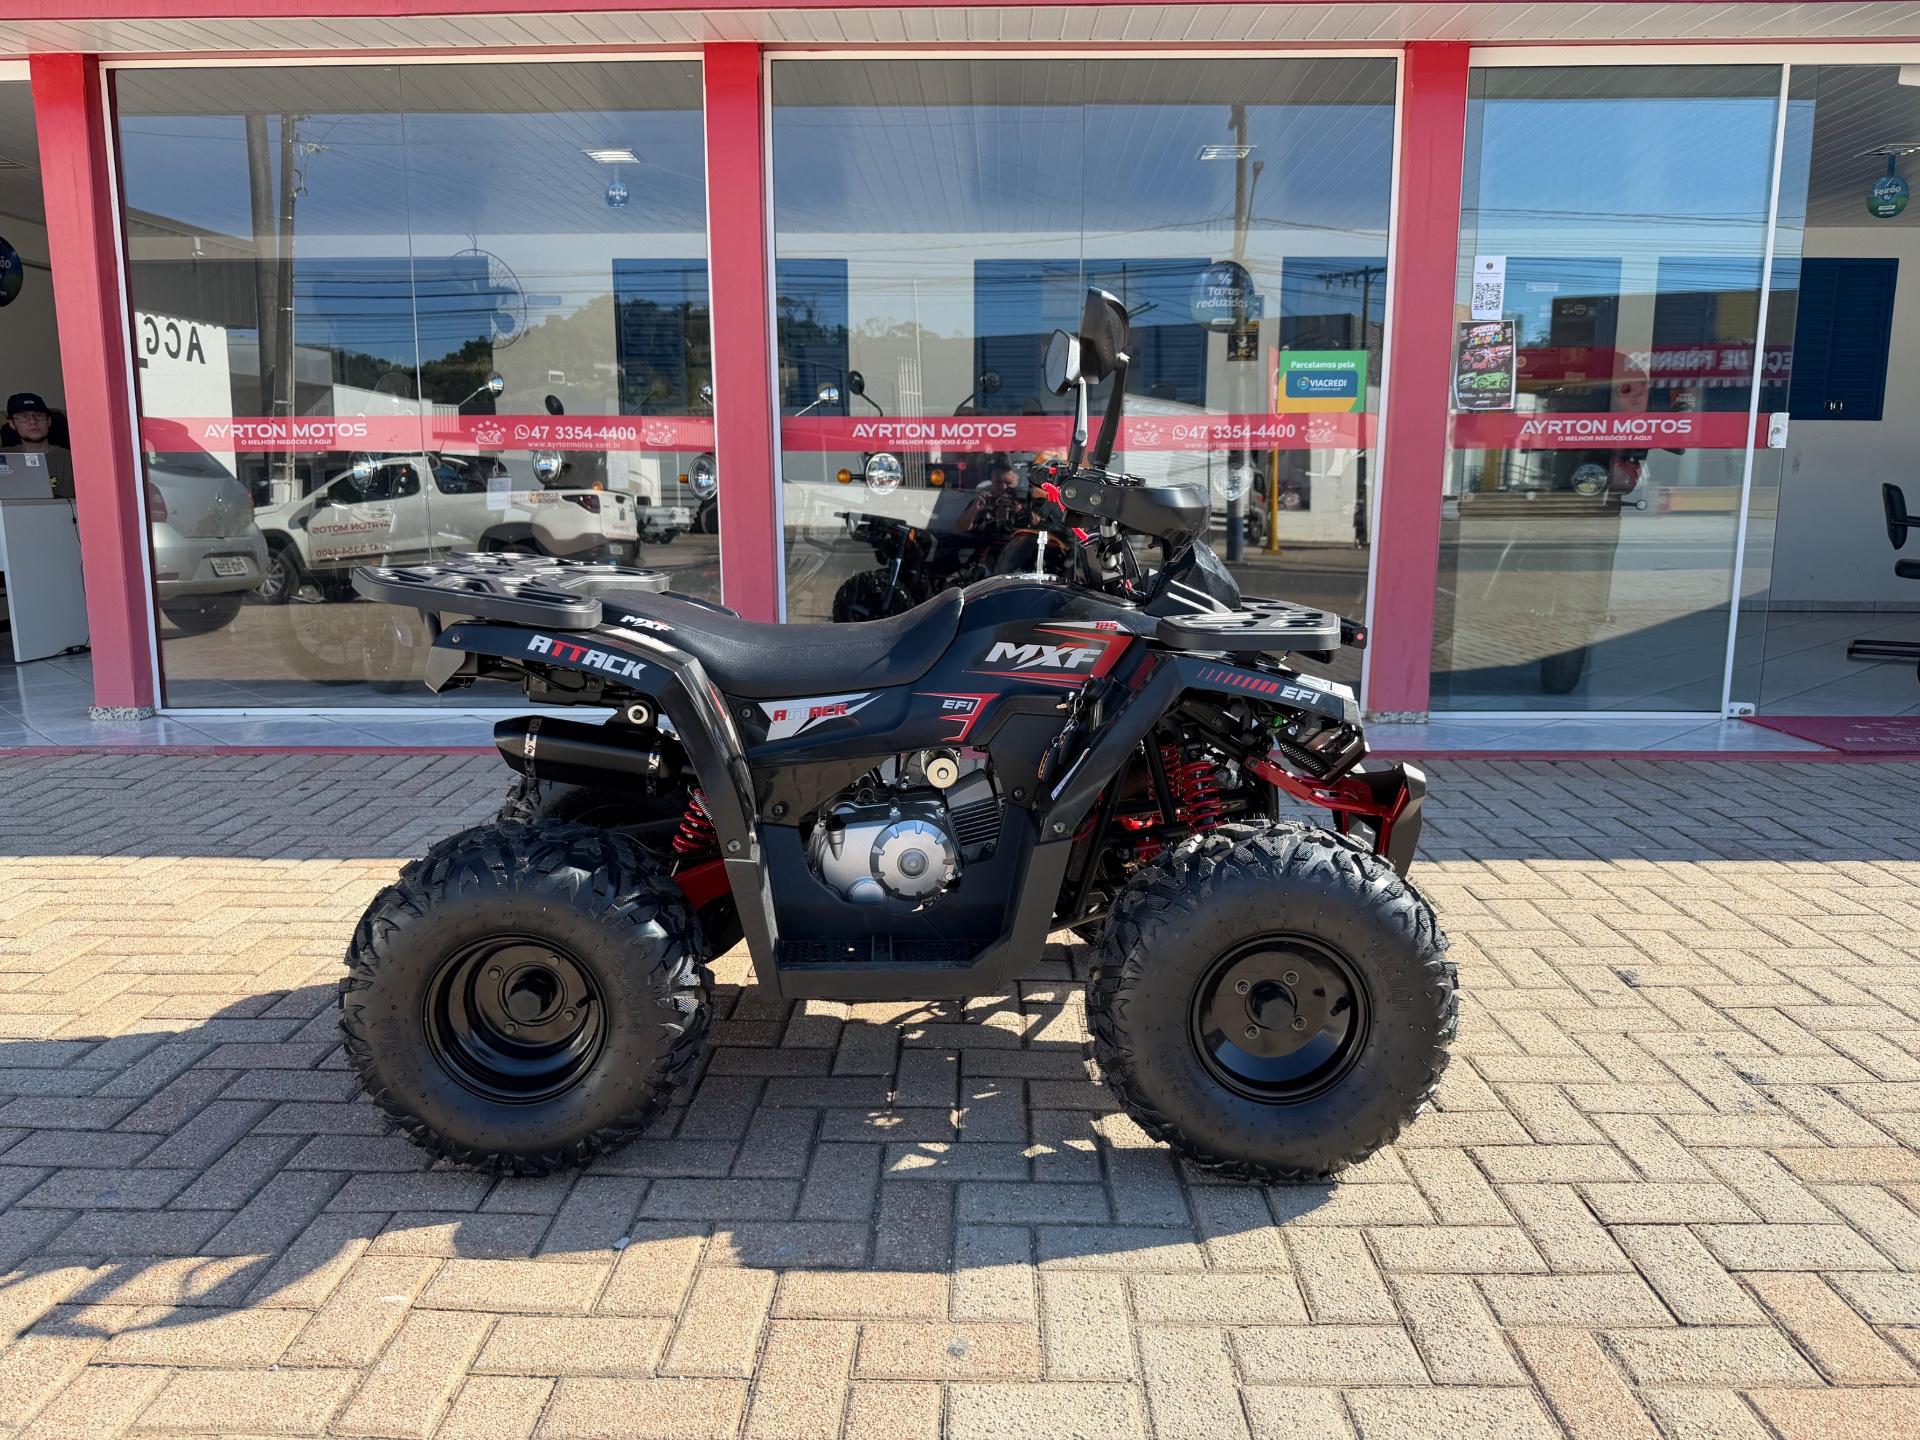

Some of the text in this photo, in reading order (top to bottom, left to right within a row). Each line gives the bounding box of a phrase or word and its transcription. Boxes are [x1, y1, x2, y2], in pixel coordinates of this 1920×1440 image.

[1208, 286, 1240, 296] Taxas
[1195, 298, 1249, 309] reduzidas
[1290, 361, 1355, 370] Parcelamos pela
[1310, 379, 1347, 387] VIACREDI
[204, 423, 368, 438] AYRTON MOTOS
[531, 426, 637, 440] 47 3354-4400
[851, 423, 1017, 438] AYRTON MOTOS
[1188, 424, 1296, 439] 47 3354-4400
[1520, 419, 1692, 434] AYRTON MOTOS
[527, 441, 621, 449] www.ayrtonmotos.com.br
[620, 615, 675, 632] MXF
[1095, 621, 1118, 631] 125
[527, 634, 647, 679] ATTACK
[984, 641, 1103, 671] MXF
[1280, 685, 1321, 705] EFI
[773, 703, 848, 721] ATTACK
[942, 699, 974, 711] EFI
